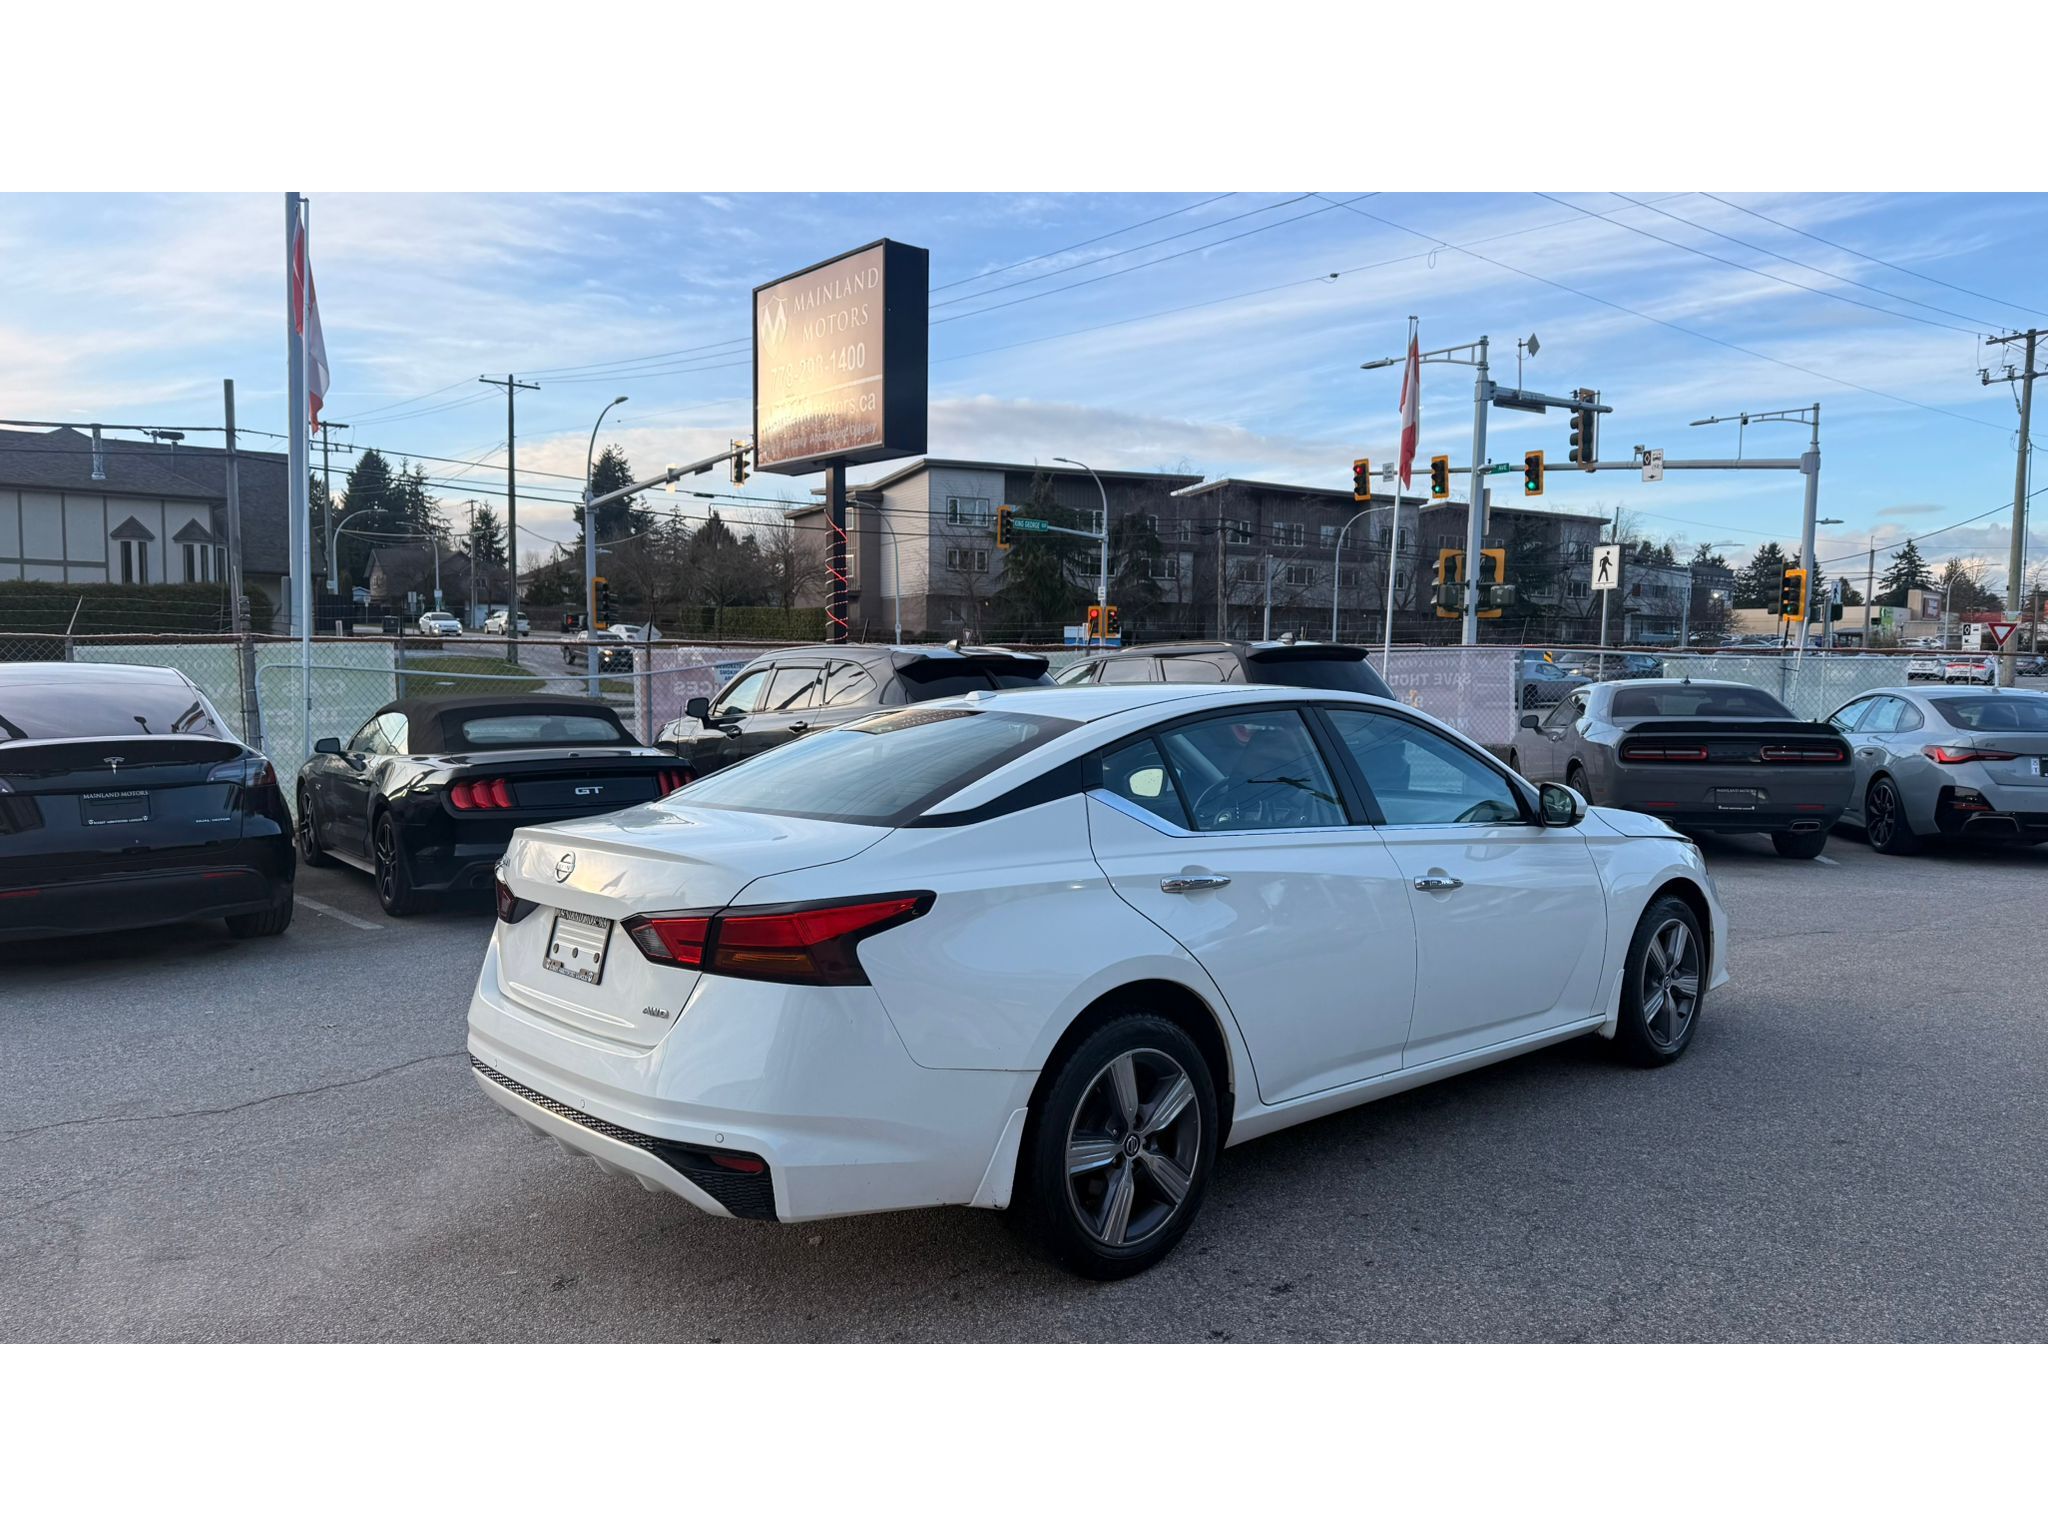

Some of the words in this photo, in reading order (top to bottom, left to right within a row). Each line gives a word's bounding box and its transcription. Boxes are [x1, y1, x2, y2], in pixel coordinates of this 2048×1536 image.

[793, 267, 879, 312] MAINLAND
[801, 303, 869, 343] MOTORS
[1024, 521, 1040, 529] GEORGE
[575, 786, 604, 795] GT
[642, 1006, 670, 1019] AWD
